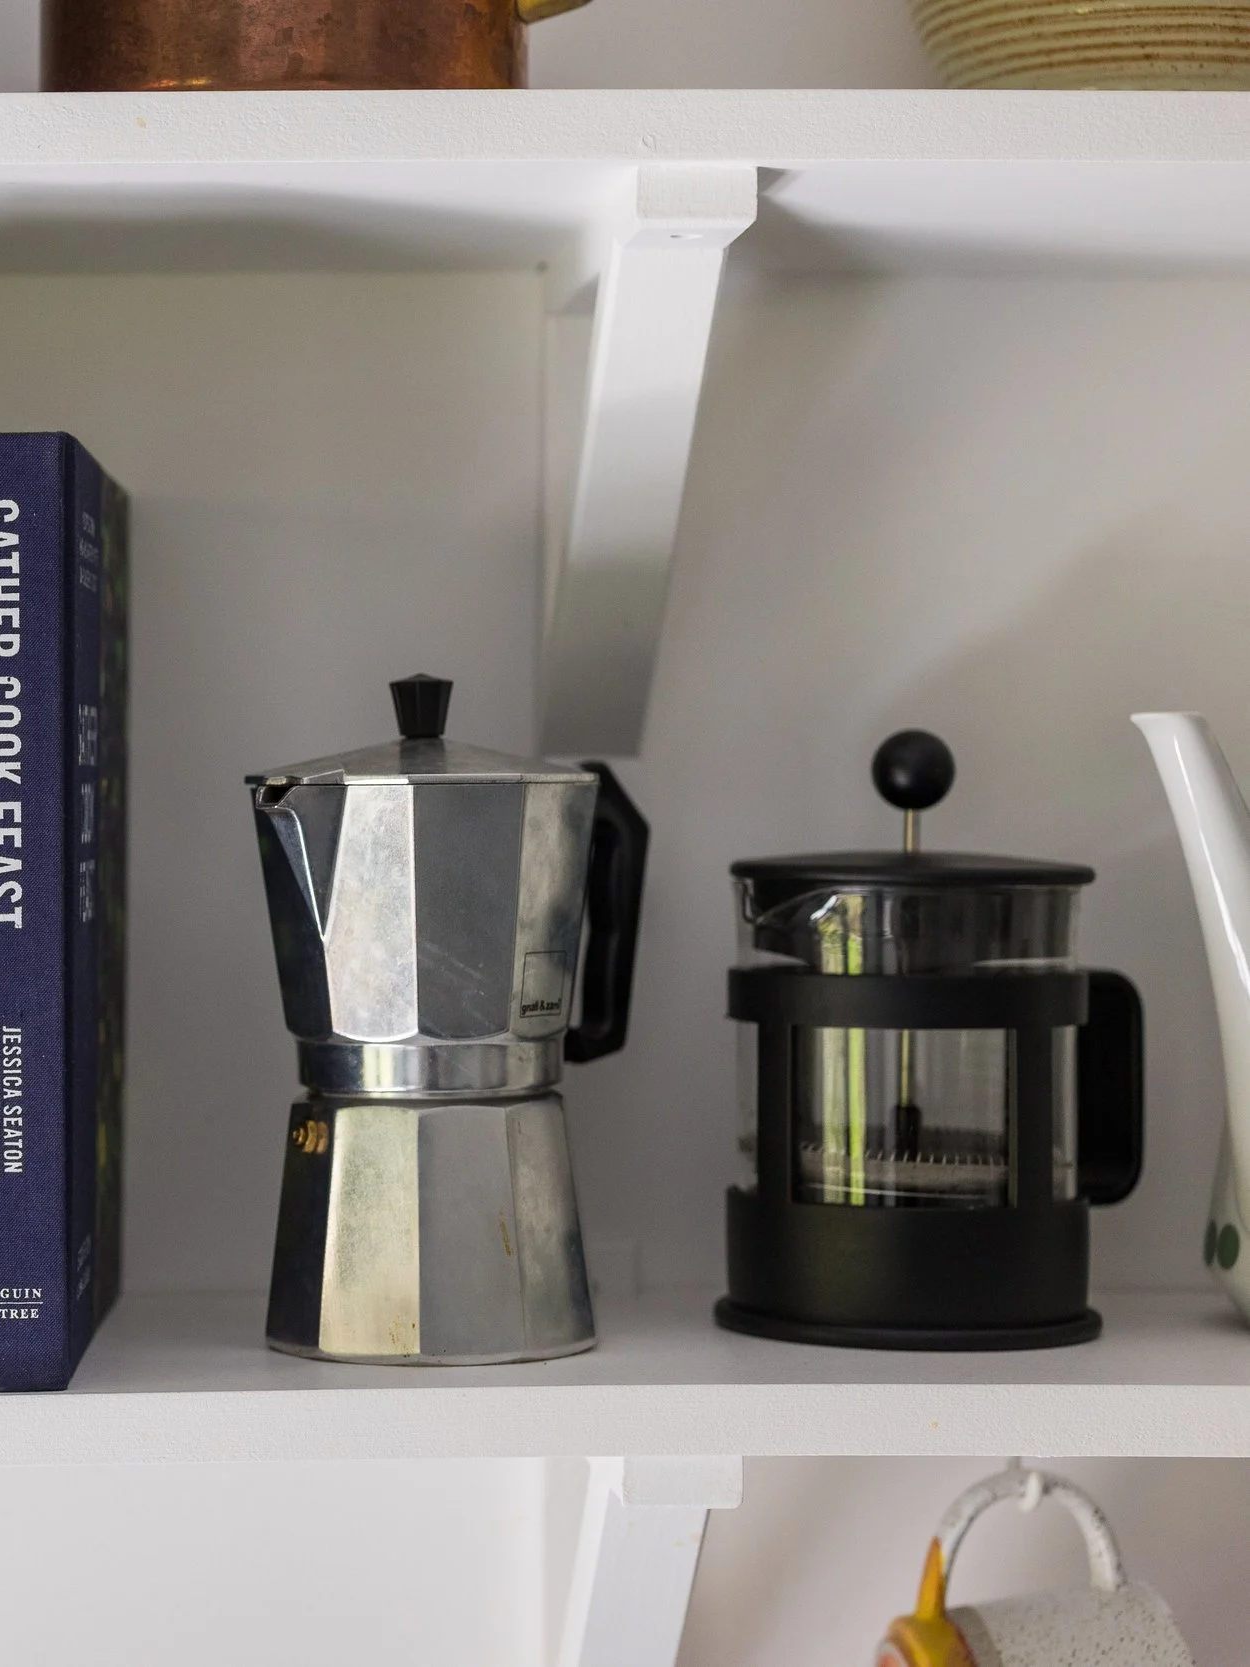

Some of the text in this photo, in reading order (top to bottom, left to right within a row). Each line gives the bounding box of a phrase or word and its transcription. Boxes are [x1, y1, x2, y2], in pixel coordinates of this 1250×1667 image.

[3, 1026, 22, 1172] JESSICA SEATON
[0, 1309, 39, 1319] TREE
